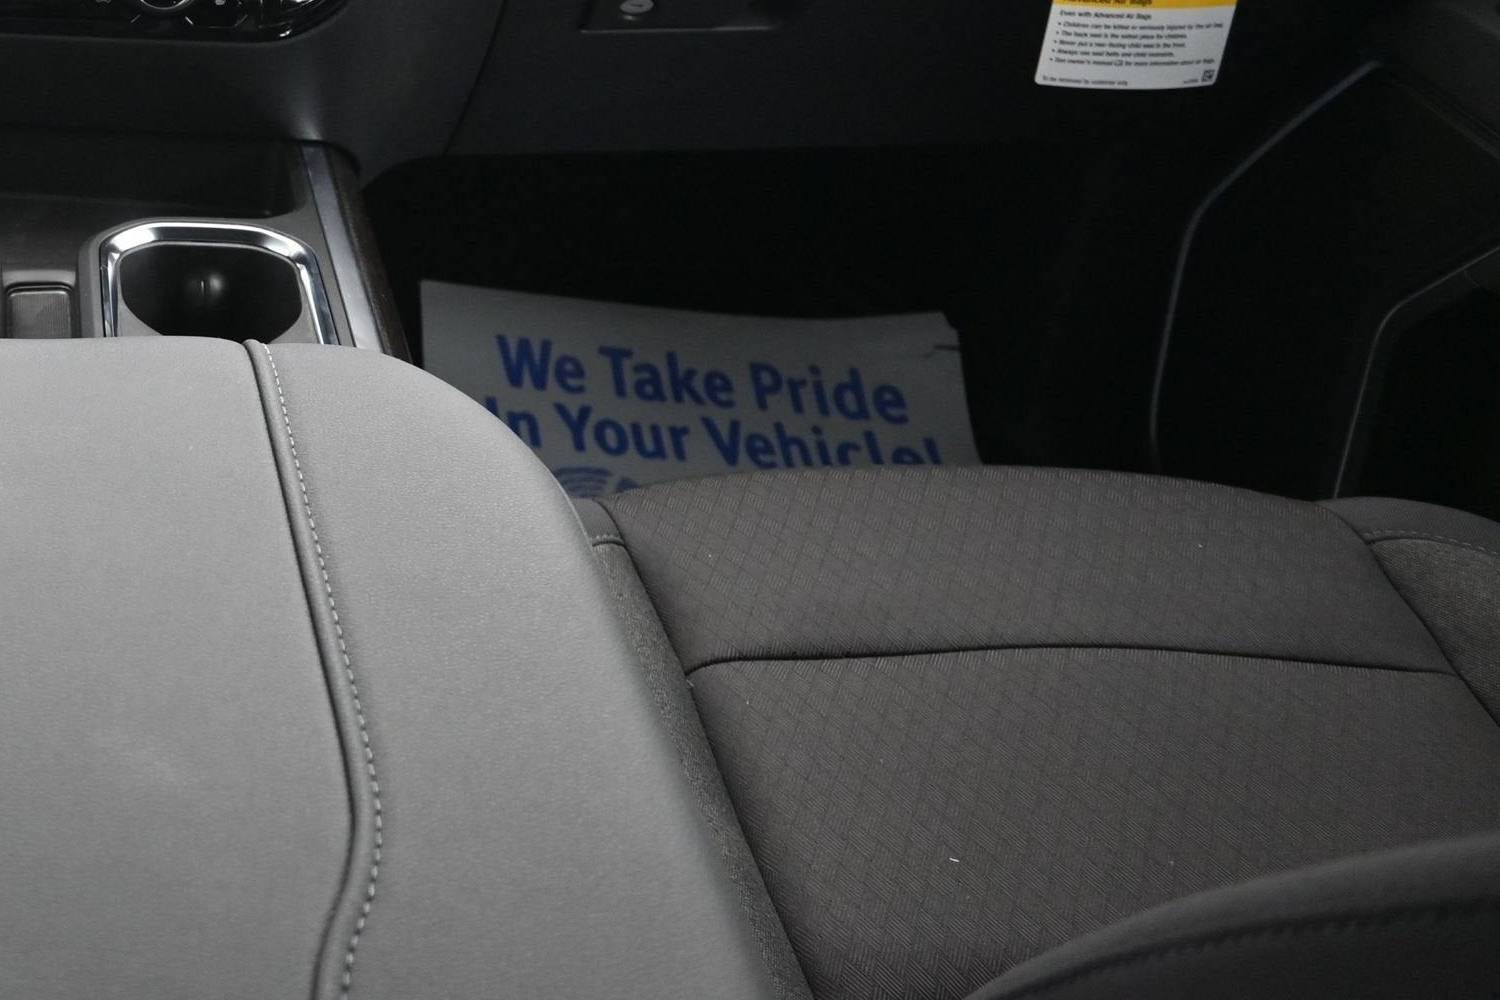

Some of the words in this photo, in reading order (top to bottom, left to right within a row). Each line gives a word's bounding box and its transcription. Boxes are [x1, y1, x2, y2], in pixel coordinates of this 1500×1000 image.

[1094, 11, 1125, 19] Advanced
[496, 333, 586, 396] We
[598, 346, 735, 410] Take
[749, 361, 908, 427] Pride
[553, 402, 690, 462] Your
